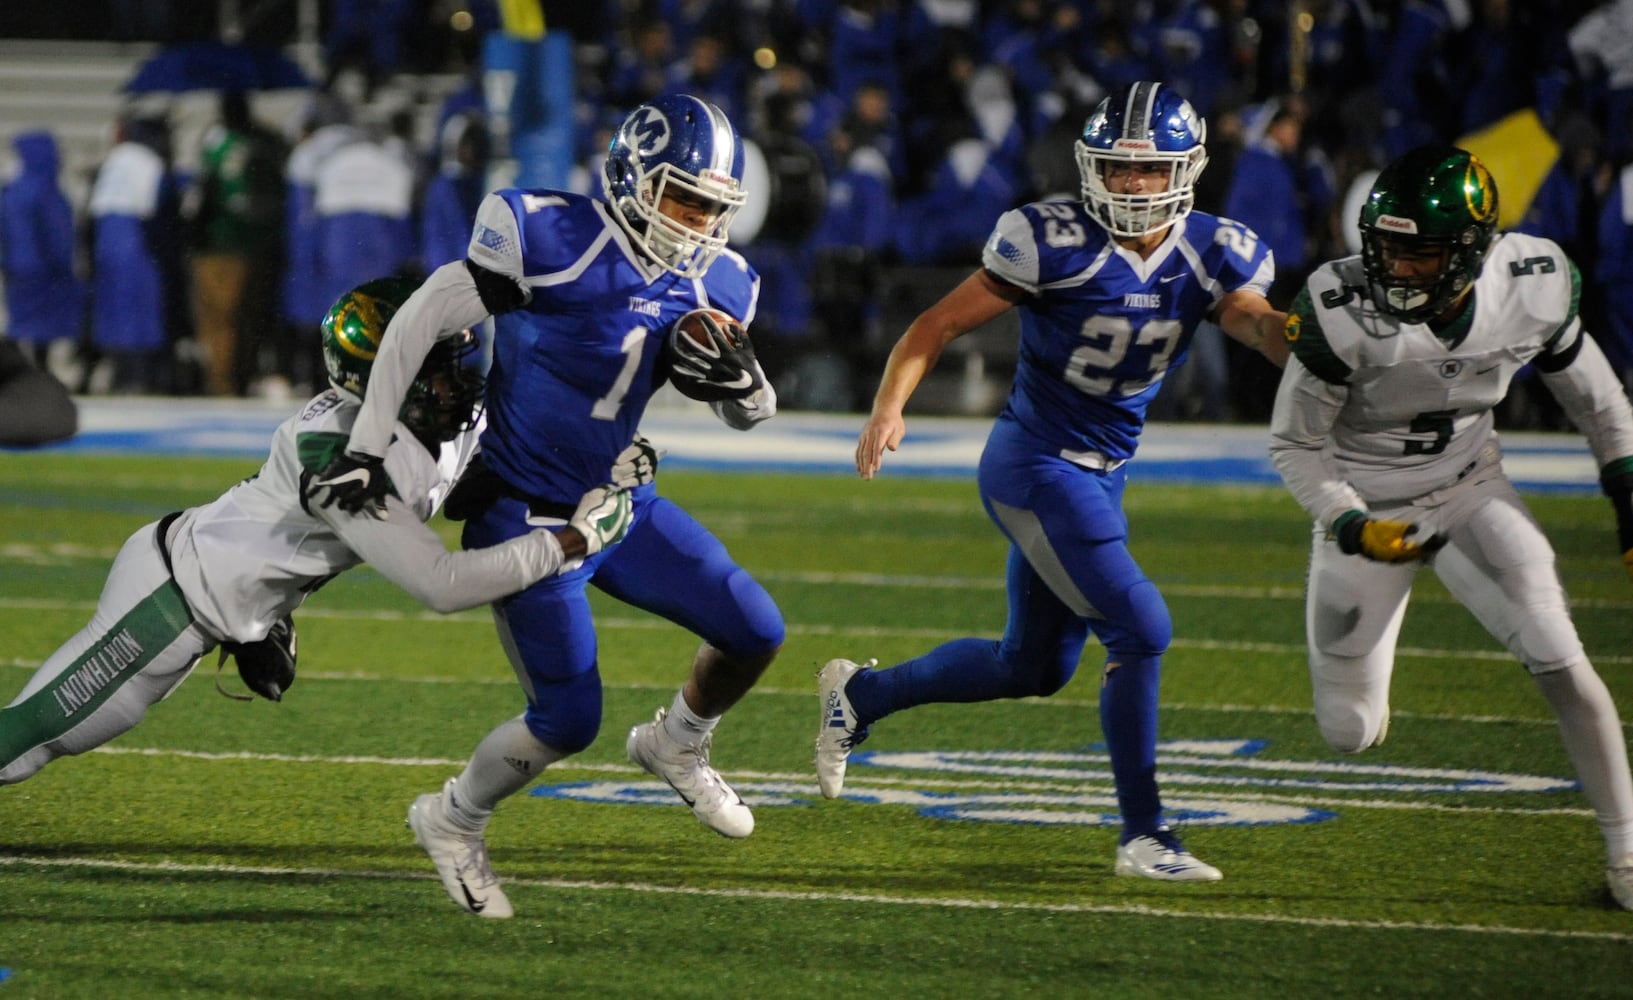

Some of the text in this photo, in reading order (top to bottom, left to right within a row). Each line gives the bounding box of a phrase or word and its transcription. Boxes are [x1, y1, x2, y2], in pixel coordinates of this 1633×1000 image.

[520, 194, 570, 214] 1
[1034, 203, 1088, 249] 23
[1380, 216, 1411, 229] Riddell
[1509, 255, 1557, 278] 5
[628, 296, 662, 318] VIKINGS
[1123, 293, 1162, 309] VIKINGS
[1064, 314, 1183, 396] 23
[590, 325, 648, 421] 1
[1402, 408, 1455, 456] 5
[52, 627, 145, 718] NORTHMONT
